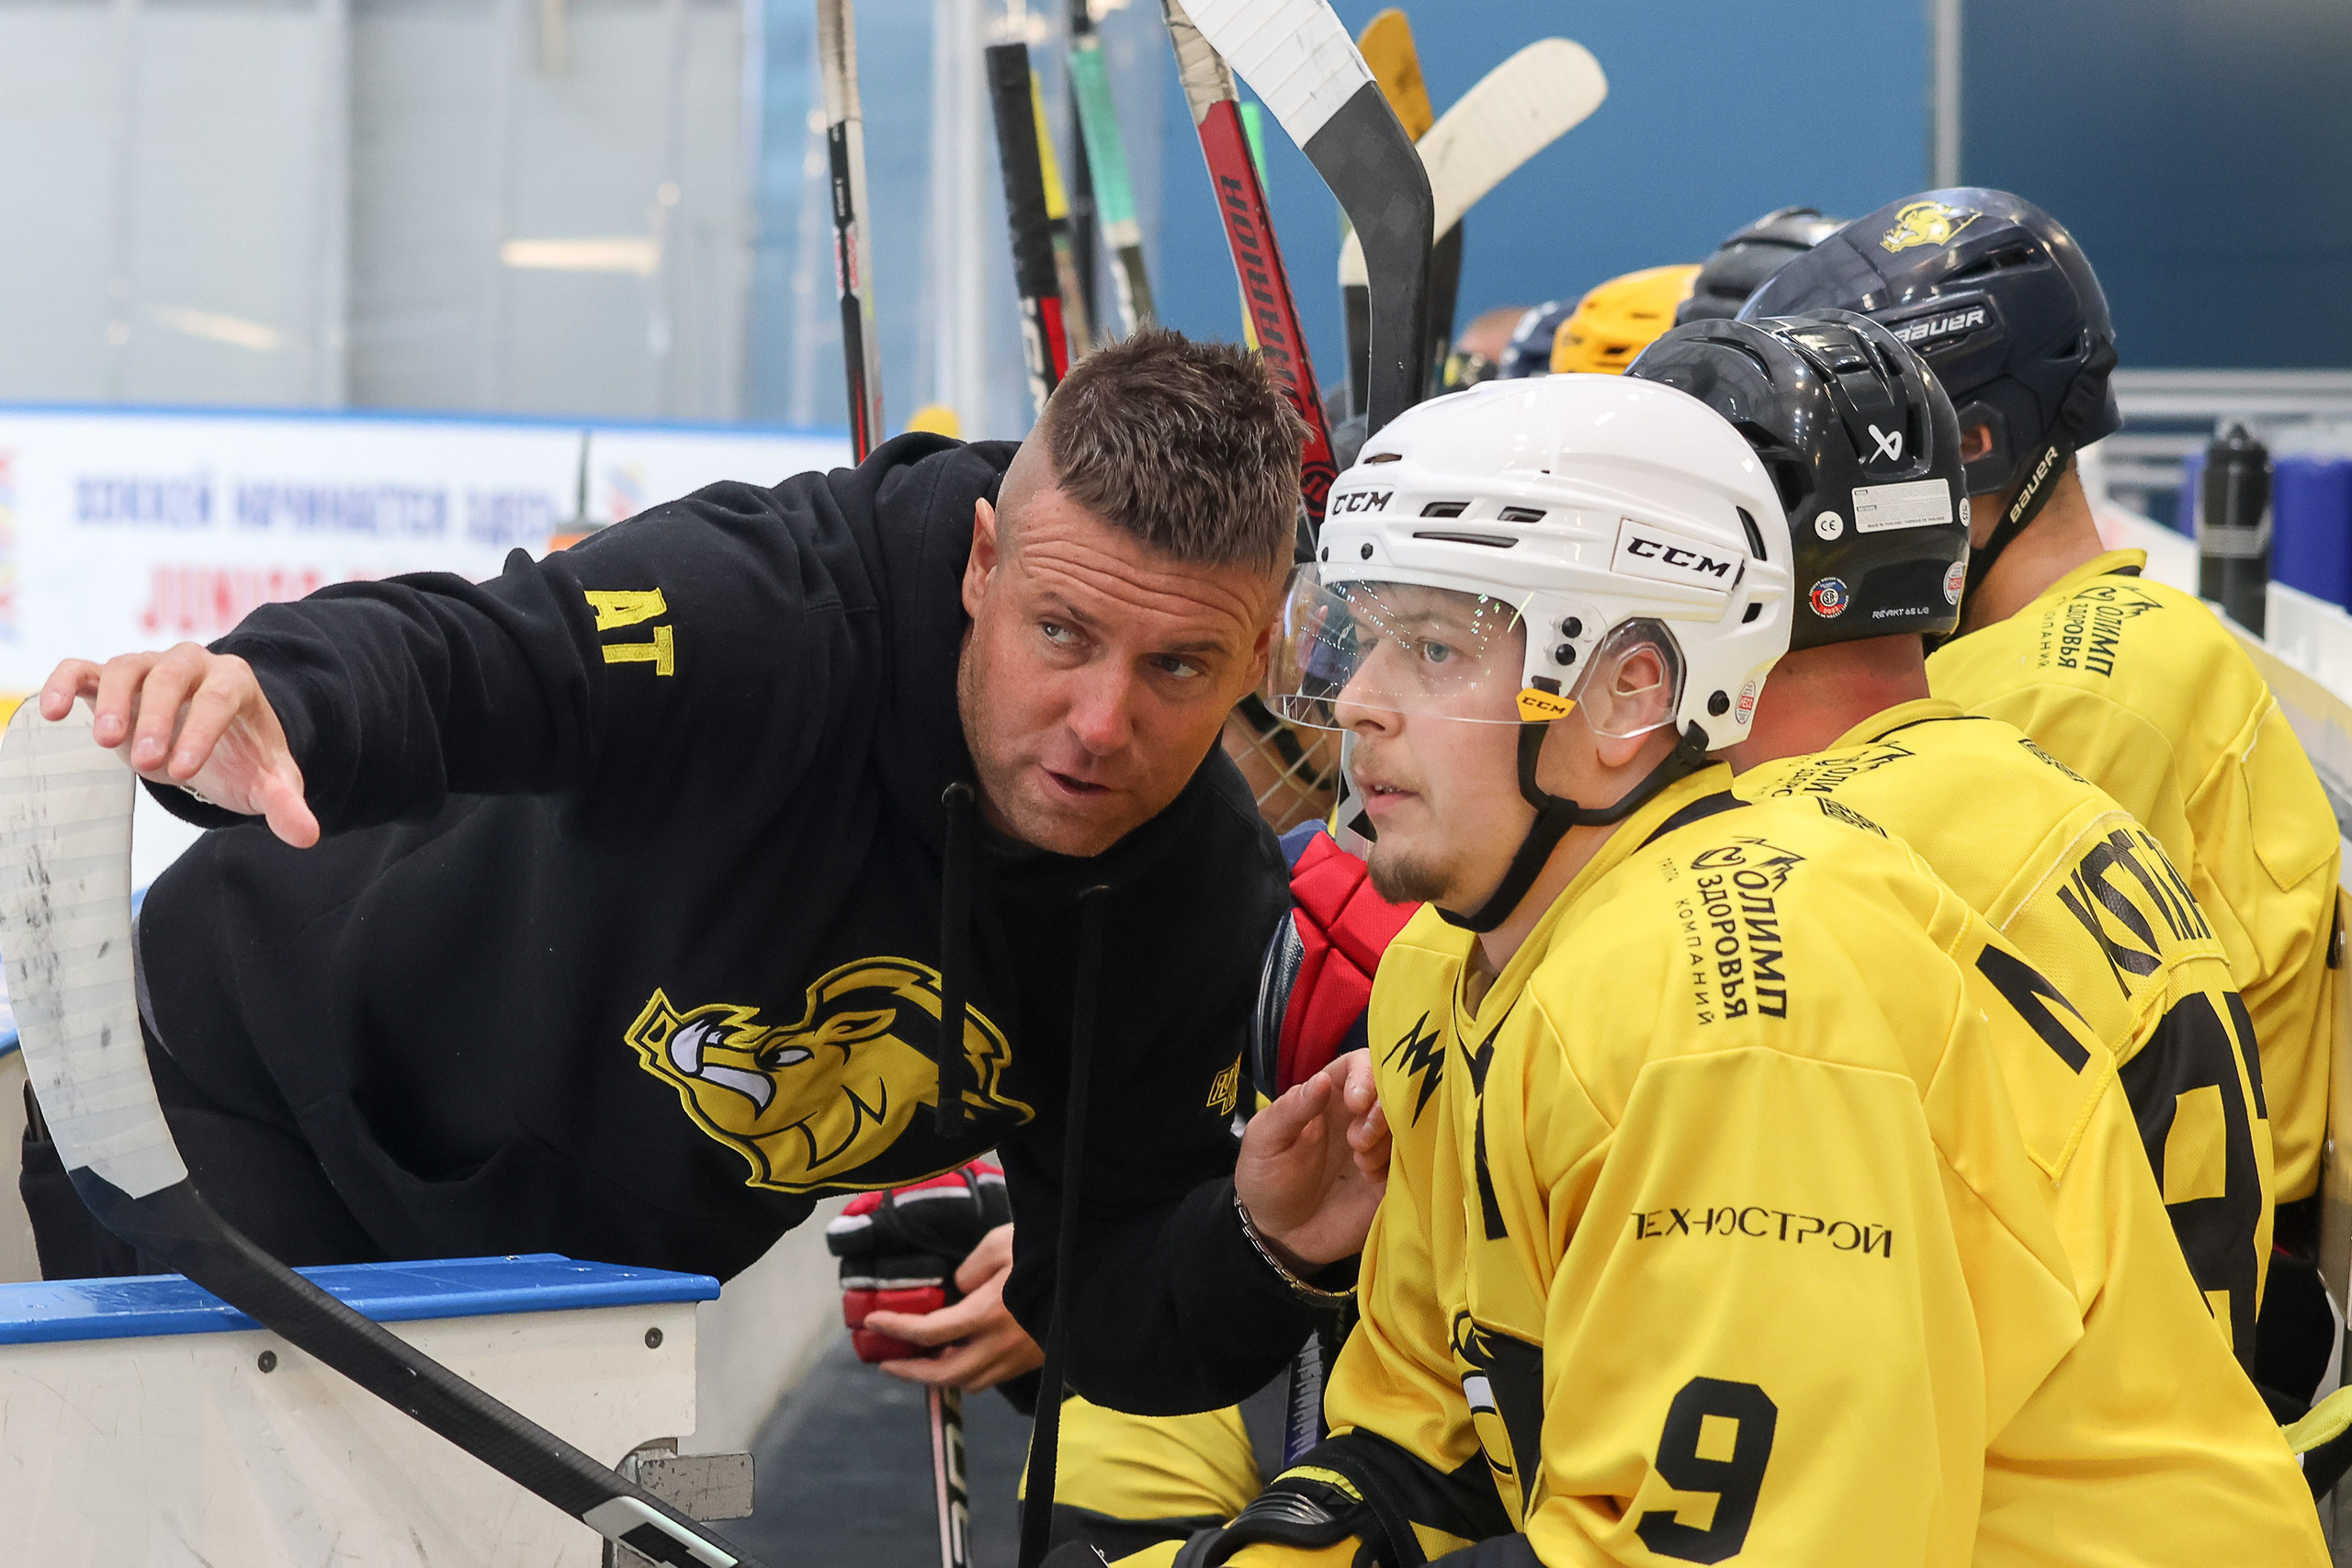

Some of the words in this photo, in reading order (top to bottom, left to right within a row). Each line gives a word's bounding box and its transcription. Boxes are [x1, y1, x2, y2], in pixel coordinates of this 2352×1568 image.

[1332, 491, 1394, 515] CCM
[2009, 446, 2058, 524] BAUER
[1627, 536, 1731, 577] CCM
[1821, 519, 1836, 531] CE
[1521, 696, 1566, 714] CCM
[1675, 897, 1715, 1026] КОМПАНИЙ
[1697, 874, 1748, 1020] ЗДОРОВЬЯ
[1733, 870, 1787, 1020] ОЛИМП
[1634, 1376, 1779, 1565] 9
